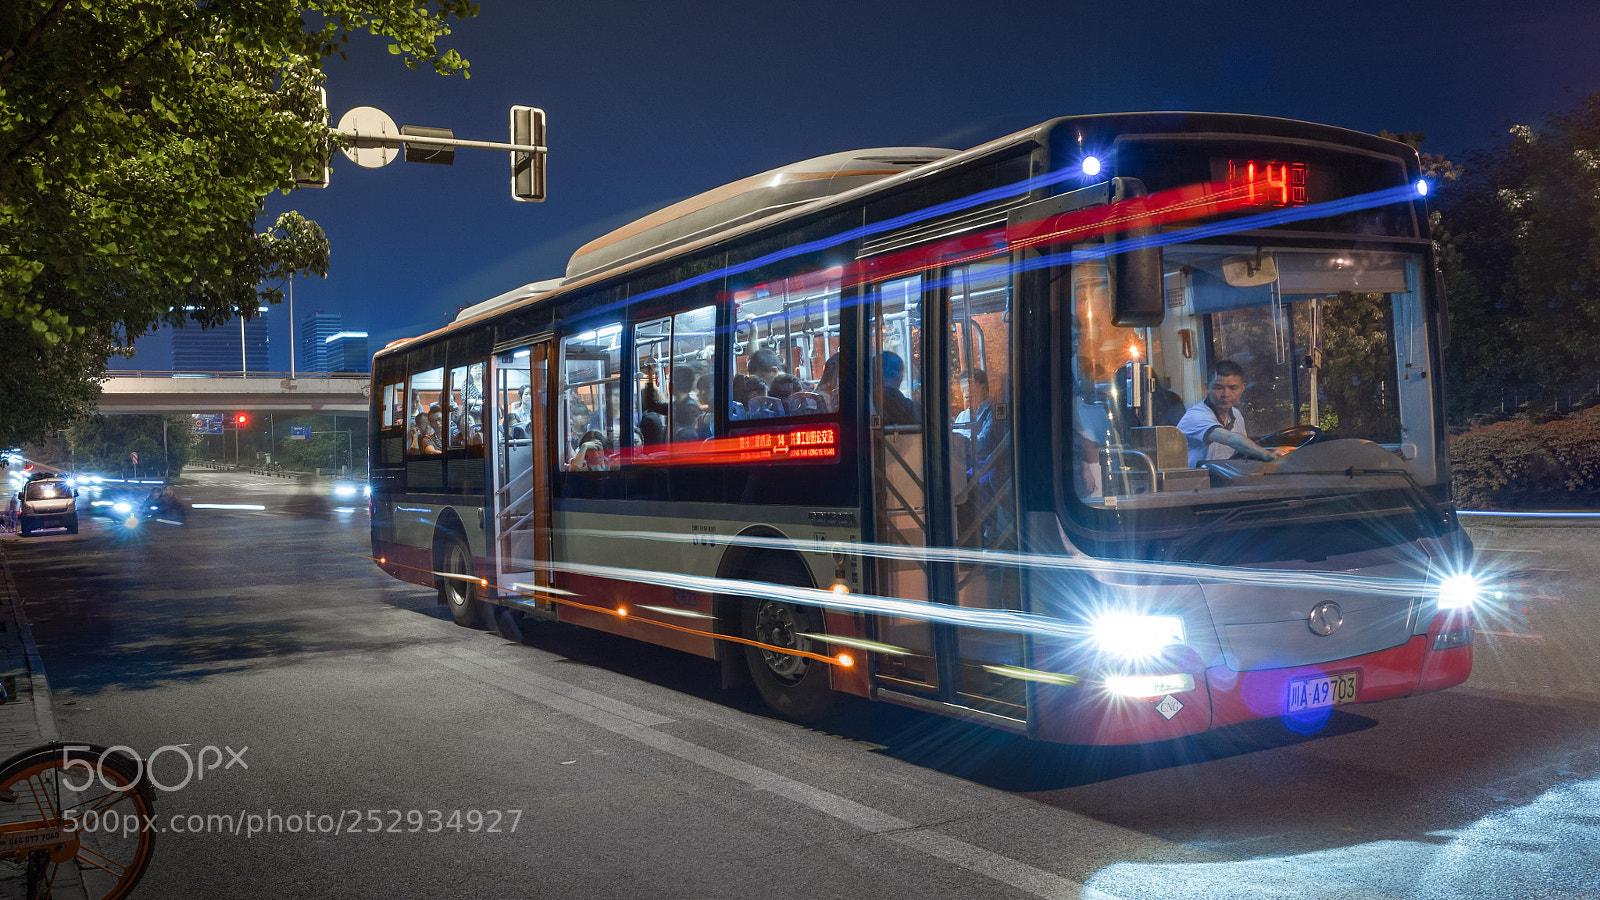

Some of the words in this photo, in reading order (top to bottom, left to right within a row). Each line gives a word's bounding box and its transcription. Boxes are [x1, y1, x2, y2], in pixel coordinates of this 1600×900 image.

[1247, 161, 1287, 204] 14
[777, 434, 785, 446] 14
[1160, 701, 1179, 713] CNG
